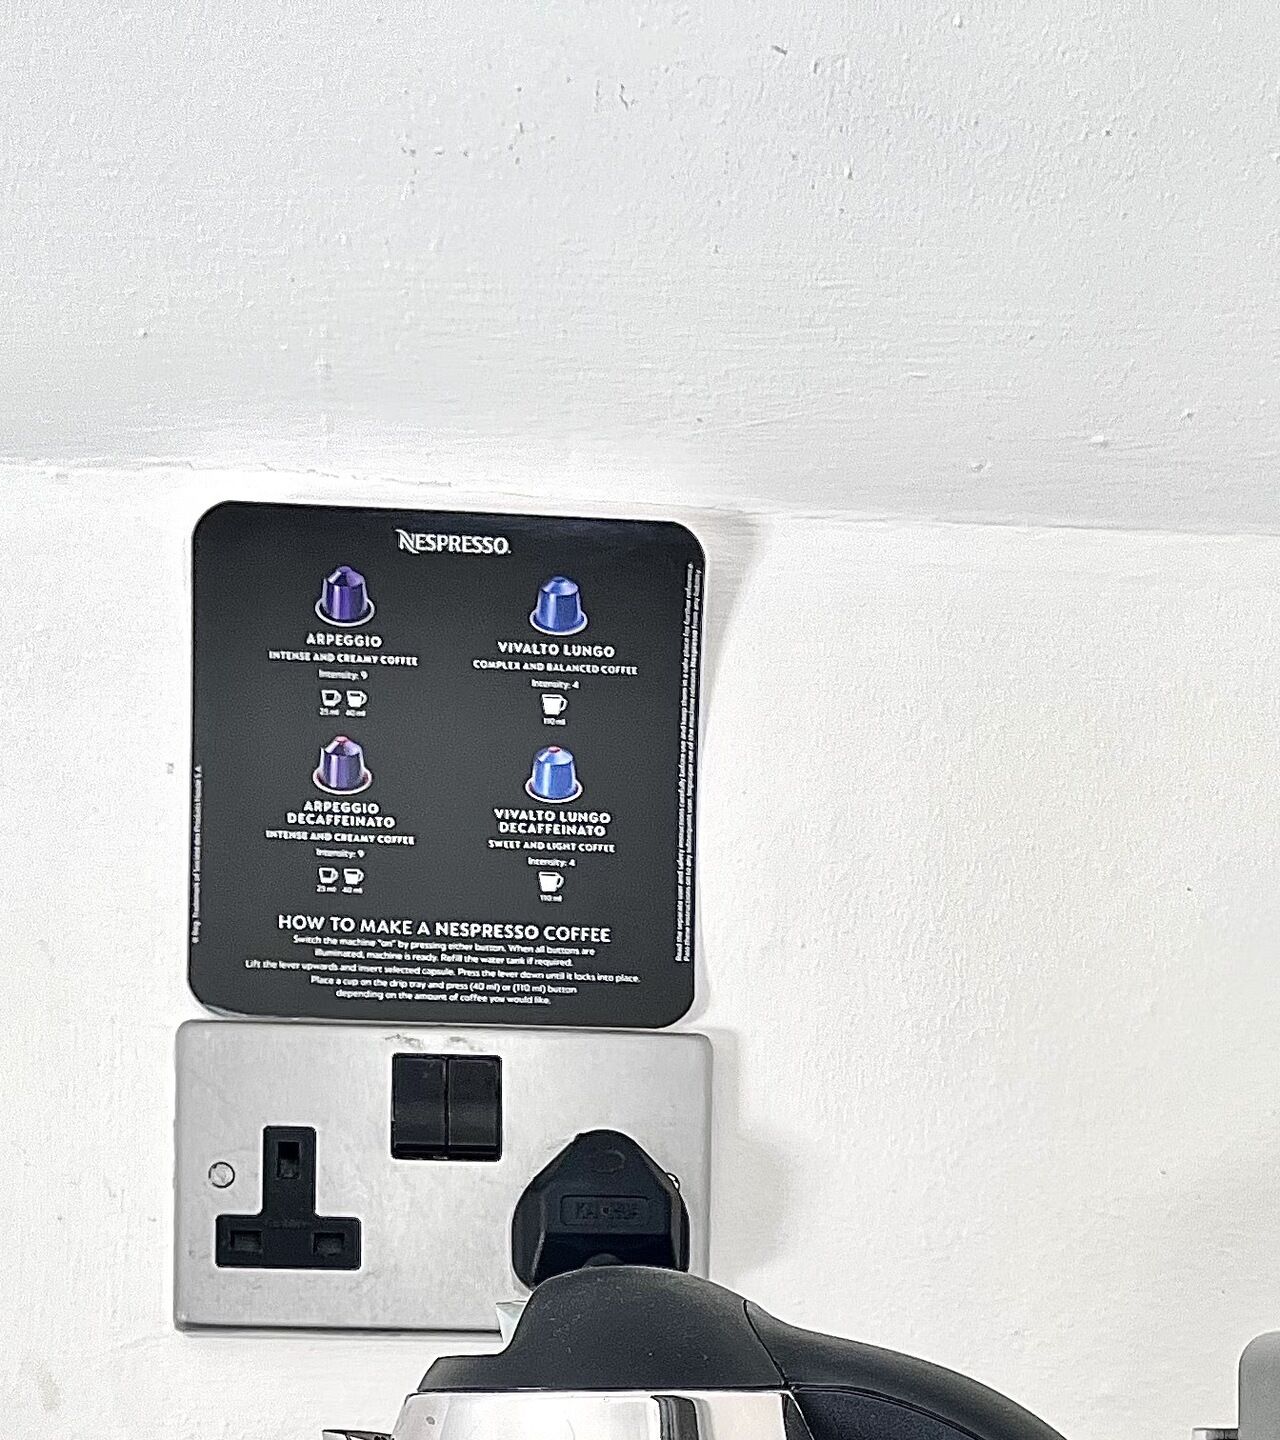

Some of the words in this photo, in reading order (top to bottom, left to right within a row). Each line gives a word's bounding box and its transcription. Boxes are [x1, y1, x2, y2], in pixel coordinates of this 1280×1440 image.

[394, 528, 512, 555] NESPRESSO
[306, 633, 383, 648] ARPEGGIO
[497, 641, 560, 656] VIVALTO
[563, 644, 616, 658] LUNGO
[268, 650, 311, 662] INTENSE
[313, 652, 336, 663] AND
[337, 654, 379, 665] CREAMY
[380, 655, 419, 667] COFFEE
[472, 659, 521, 671] COMPLEX
[523, 662, 546, 672] AND
[546, 662, 600, 674] BALANCED
[600, 665, 638, 676] COFFEE
[303, 800, 380, 815] ARPEGGIO
[286, 812, 396, 829] DECAFFEINATO
[493, 808, 556, 822] VIVALTO
[559, 811, 612, 825] LUNGO
[265, 830, 308, 841] INTENSE
[309, 832, 333, 842] AND
[333, 833, 376, 844] CREAMY
[377, 835, 415, 846] COFFEE
[498, 822, 607, 837] DECAFFEINATO
[488, 839, 521, 850] SWEET
[523, 841, 546, 851] AND
[546, 842, 578, 852] LIGHT
[578, 843, 616, 853] COFFEE
[278, 914, 326, 930] HOW
[329, 916, 356, 932] TO
[359, 918, 413, 935] MAKE
[417, 921, 431, 936] A
[435, 922, 539, 940] NESPRESSO
[543, 926, 611, 943] COFFEE
[293, 934, 321, 944] Switch
[323, 936, 338, 945] the
[339, 937, 376, 947] machine
[397, 940, 409, 950] by
[410, 941, 446, 952] pressing
[448, 942, 473, 951] either
[508, 944, 534, 953] When
[535, 945, 545, 953] all
[547, 946, 580, 956] buttons
[581, 948, 596, 956] are
[366, 951, 402, 961] machine
[404, 952, 411, 961] is
[412, 953, 439, 963] ready.
[440, 953, 462, 963] Refill
[464, 955, 478, 964] the
[480, 956, 504, 965] water
[506, 956, 525, 965] tank
[527, 957, 534, 966] if
[535, 958, 573, 968] required.
[245, 959, 261, 969] Lift
[263, 960, 277, 969] the
[278, 961, 300, 970] lever
[301, 962, 339, 972] upwards
[340, 963, 356, 972] and
[358, 964, 383, 974] insert
[384, 965, 420, 975] selected
[457, 968, 481, 977] Press
[482, 969, 496, 978] the
[497, 970, 519, 979] lever
[520, 971, 545, 980] down
[546, 972, 564, 980] until
[566, 972, 573, 981] it
[573, 972, 596, 981] locks
[597, 973, 615, 982] into
[616, 974, 640, 984] place.
[310, 975, 334, 985] Place
[342, 978, 359, 987] cup
[373, 978, 388, 987] the
[389, 979, 408, 989] drip
[409, 981, 426, 991] tray
[427, 981, 444, 989] and
[445, 982, 468, 992] press
[469, 982, 485, 992] (40
[486, 983, 501, 993] ml)
[531, 984, 546, 994] ml)
[547, 985, 578, 994] button
[335, 989, 384, 1000] depending
[385, 992, 397, 1000] on
[398, 991, 413, 1000] the
[414, 993, 447, 1001] amount
[449, 993, 459, 1002] of
[460, 994, 488, 1003] coffee
[489, 995, 505, 1005] you
[506, 995, 534, 1004] would
